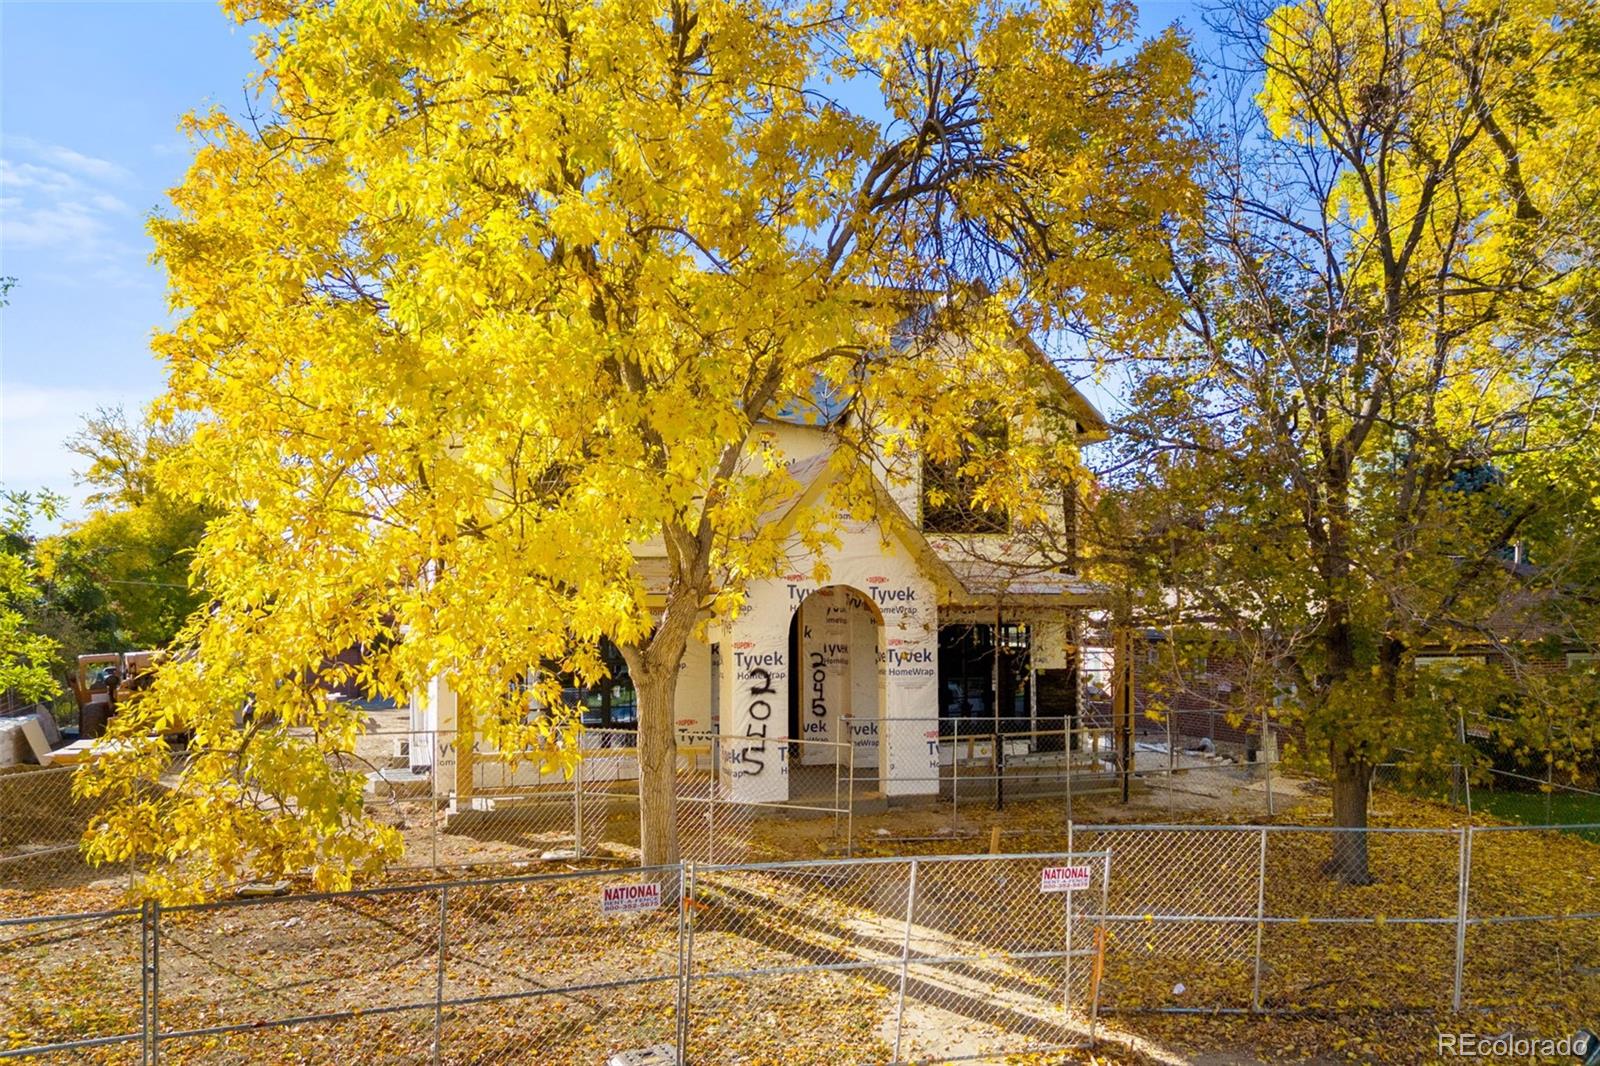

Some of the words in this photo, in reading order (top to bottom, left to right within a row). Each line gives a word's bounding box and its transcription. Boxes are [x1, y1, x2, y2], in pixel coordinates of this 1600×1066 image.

[869, 586, 916, 605] Tyvek
[880, 606, 918, 616] omeWrap
[734, 651, 784, 670] Tyvek
[888, 648, 933, 667] Tyvek
[889, 668, 935, 677] HomeWrap
[810, 652, 827, 717] 2045
[742, 667, 776, 776] 2045
[803, 720, 827, 733] vek
[678, 728, 713, 745] Tyve
[1044, 867, 1089, 880] NATIONAL
[604, 884, 659, 901] NATIONAL
